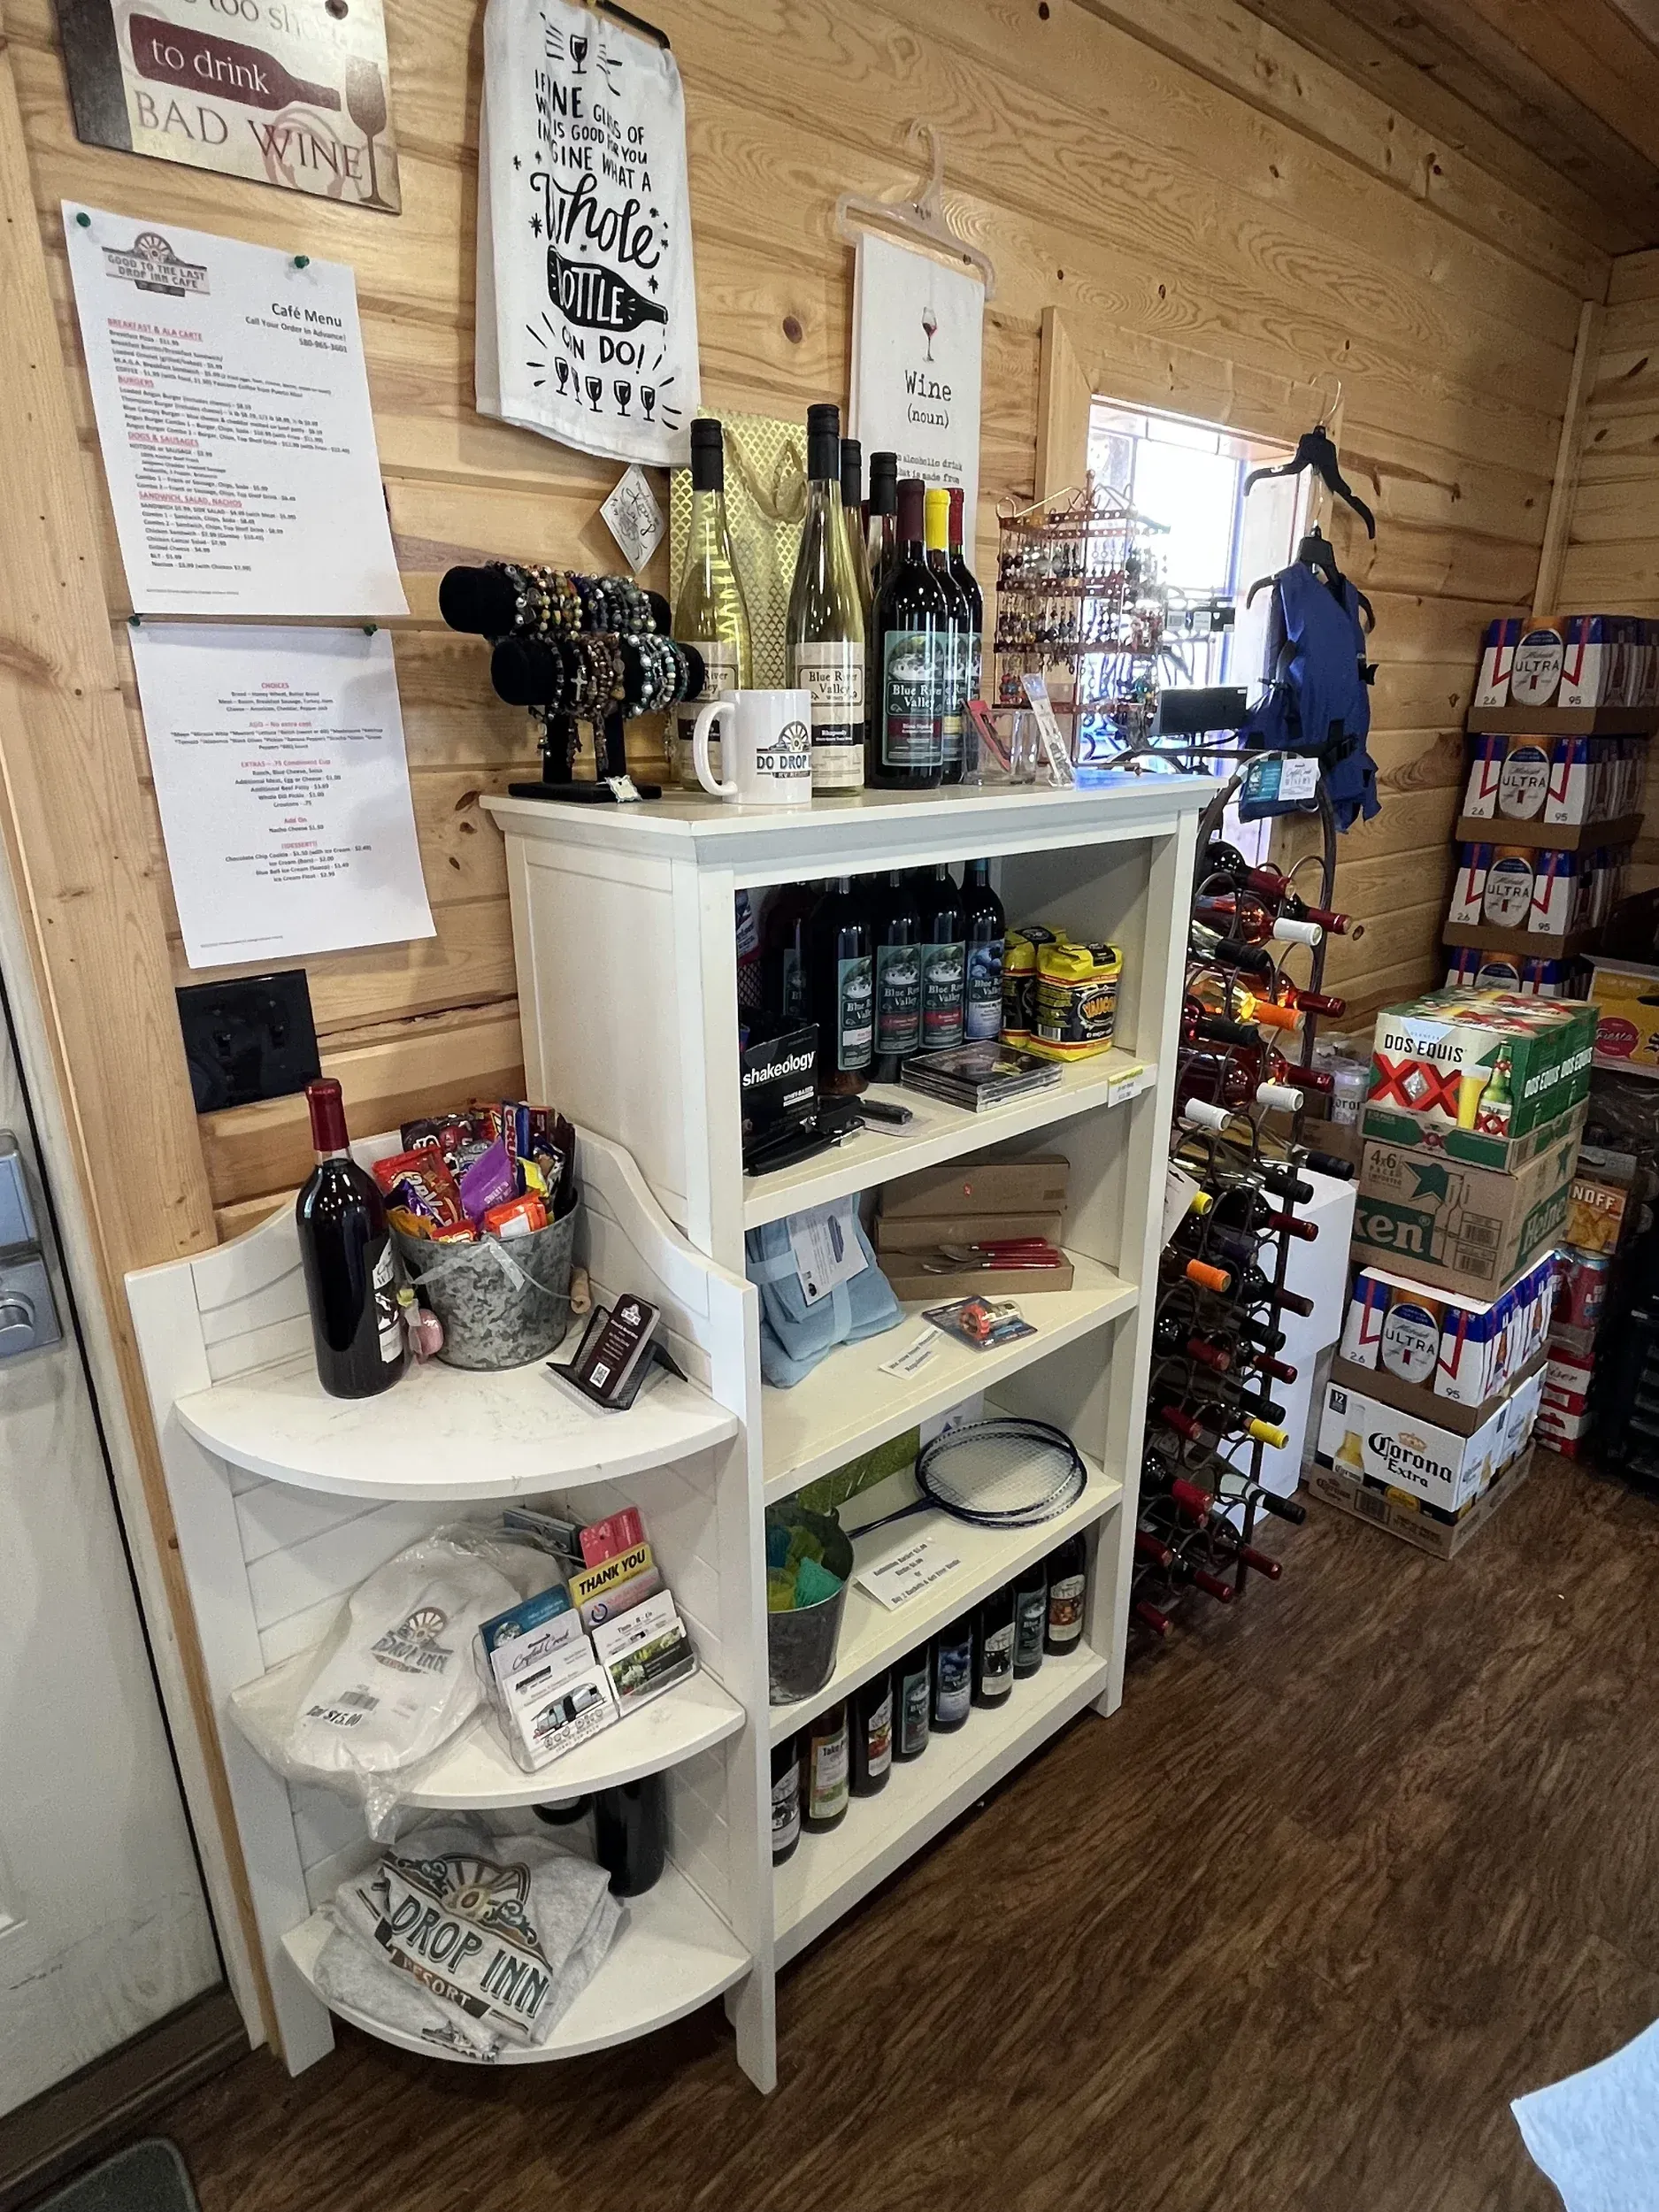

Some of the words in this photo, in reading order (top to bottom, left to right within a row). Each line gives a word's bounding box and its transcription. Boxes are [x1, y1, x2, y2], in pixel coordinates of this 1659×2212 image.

[152, 38, 184, 70] to
[194, 50, 270, 95] drink
[133, 89, 228, 145] BAD
[248, 119, 364, 181] WINE
[554, 120, 565, 139] IS
[571, 125, 605, 144] GOOD
[621, 145, 647, 165] YOU
[627, 127, 644, 145] OF
[603, 152, 635, 189] WHAT
[641, 172, 651, 192] A
[530, 173, 660, 269] Whole
[108, 254, 137, 268] GOOD
[141, 260, 154, 272] TO
[157, 264, 178, 276] THE
[180, 267, 204, 280] LAST
[119, 266, 147, 280] DROP
[150, 272, 168, 283] INN
[172, 275, 197, 289] CAFE
[245, 316, 259, 326] Call
[261, 319, 279, 330] Your
[281, 321, 302, 333] Order
[272, 302, 302, 319] Café
[304, 309, 342, 327] Menu
[108, 317, 151, 333] BREAKFAST
[179, 329, 203, 342] CARTE
[600, 335, 645, 374] DO!
[118, 374, 155, 388] BURGERS
[905, 370, 952, 402] Wine
[907, 403, 949, 429] (noun)
[128, 432, 150, 442] DOGS
[160, 434, 199, 449] SAUSAGES
[902, 455, 941, 468] alcoholic
[942, 458, 963, 472] drink
[921, 472, 941, 482] made
[942, 474, 960, 485] from
[809, 671, 834, 682] Blue
[1516, 659, 1560, 672] ULTRA
[892, 684, 918, 696] Blue
[903, 695, 935, 708] Valley
[1569, 695, 1582, 705] 95
[757, 756, 774, 769] DO
[780, 755, 807, 769] DROP
[1502, 775, 1548, 788] ULTRA
[1555, 812, 1568, 822] 95
[1487, 885, 1531, 899] ULTRA
[1538, 922, 1551, 932] 95
[1385, 1033, 1414, 1054] DOS
[1417, 1041, 1464, 1064] EQUIS
[742, 1050, 816, 1087] shakeology
[1524, 1075, 1540, 1099] DOS
[1384, 1327, 1436, 1356] ULTRA
[1446, 1386, 1461, 1400] 95
[1369, 1432, 1452, 1484] Corona
[1387, 1459, 1429, 1488] Extra
[579, 1565, 619, 1595] THANK
[621, 1548, 646, 1572] YOU
[391, 1894, 484, 1974] DROP
[480, 1949, 550, 2019] INN
[403, 1958, 472, 2008] RESORT
